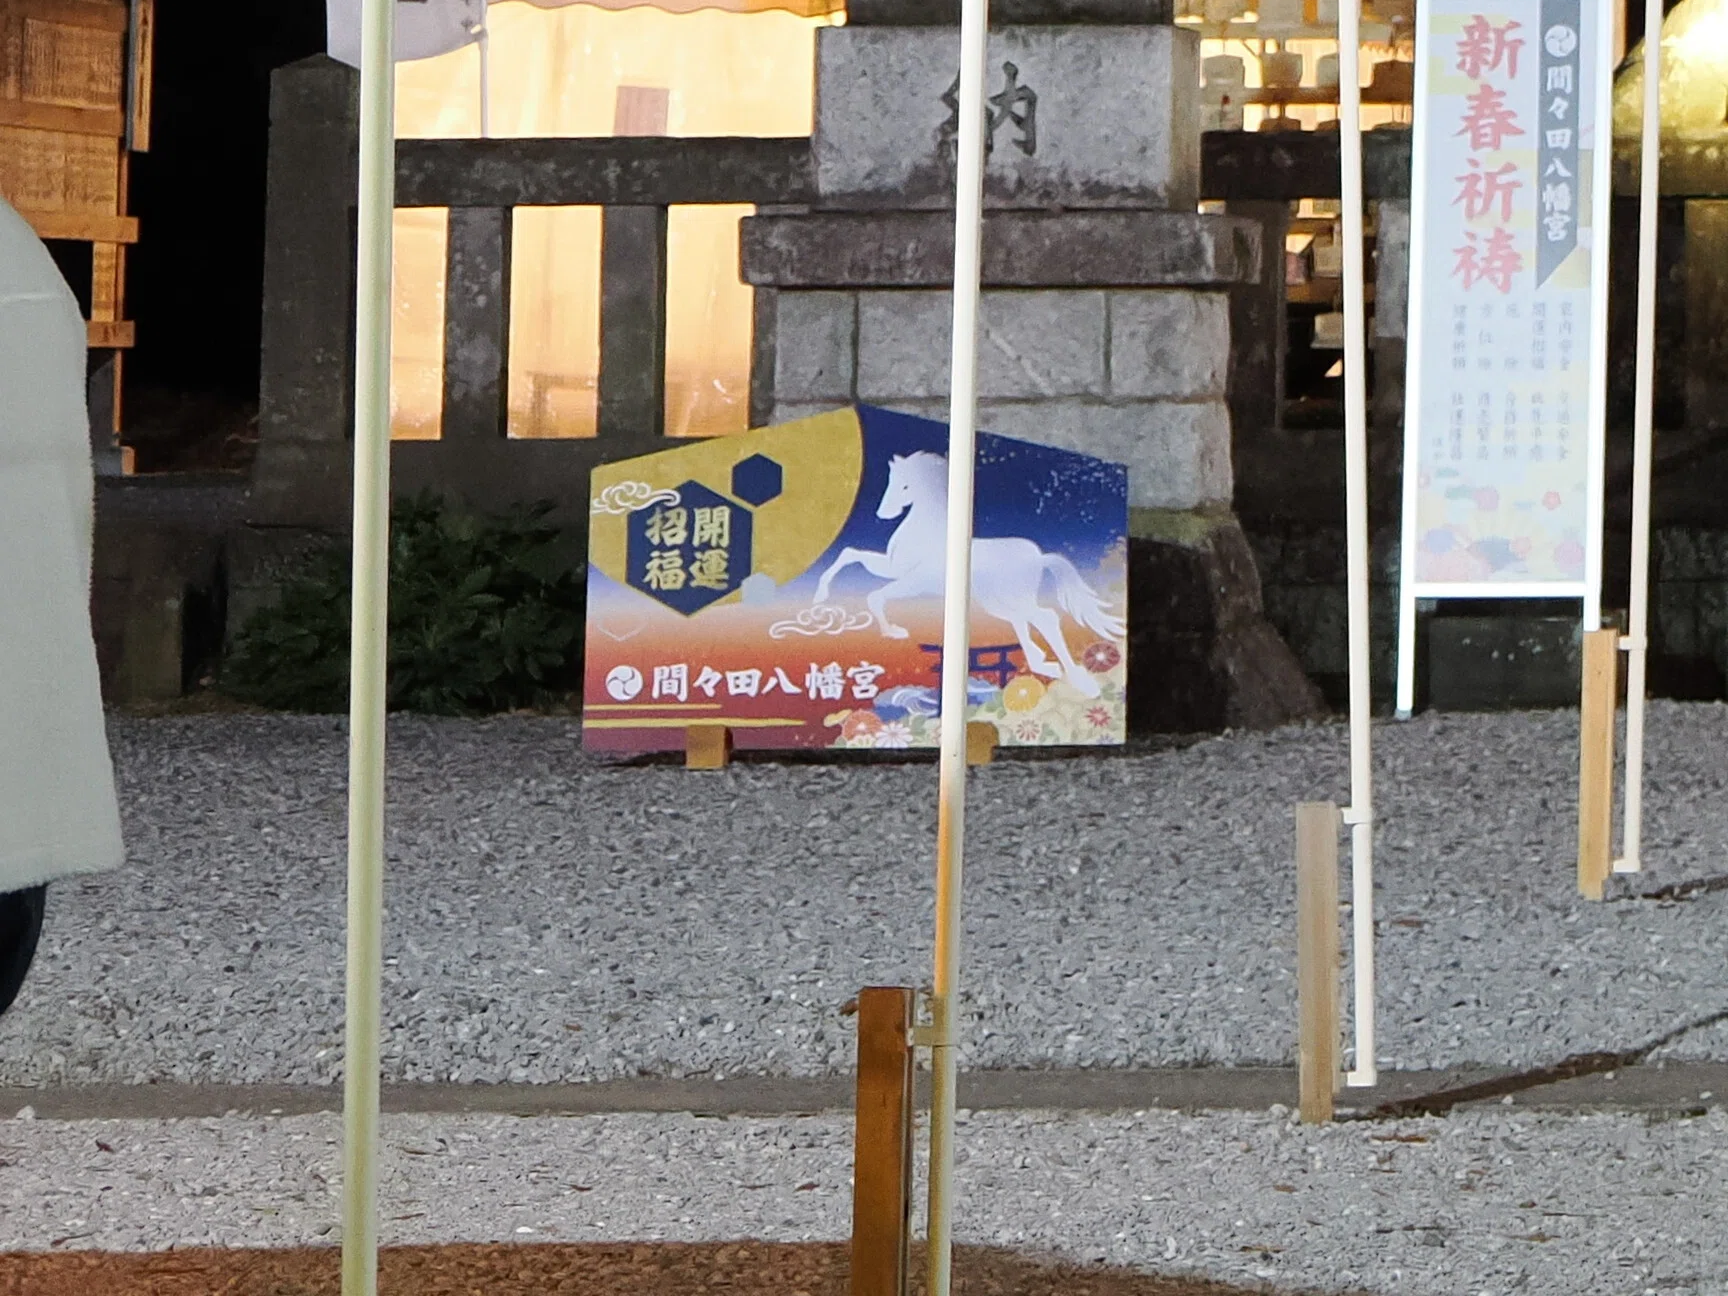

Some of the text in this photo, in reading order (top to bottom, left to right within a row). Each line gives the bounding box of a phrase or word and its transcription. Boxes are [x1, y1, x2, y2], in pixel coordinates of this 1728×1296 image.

[1450, 13, 1526, 295] 新春祈祷
[1541, 64, 1574, 243] 間々田八幡宮
[643, 505, 690, 591] 招福
[692, 504, 731, 590] 開運
[651, 660, 886, 702] 間々田八幡宮
